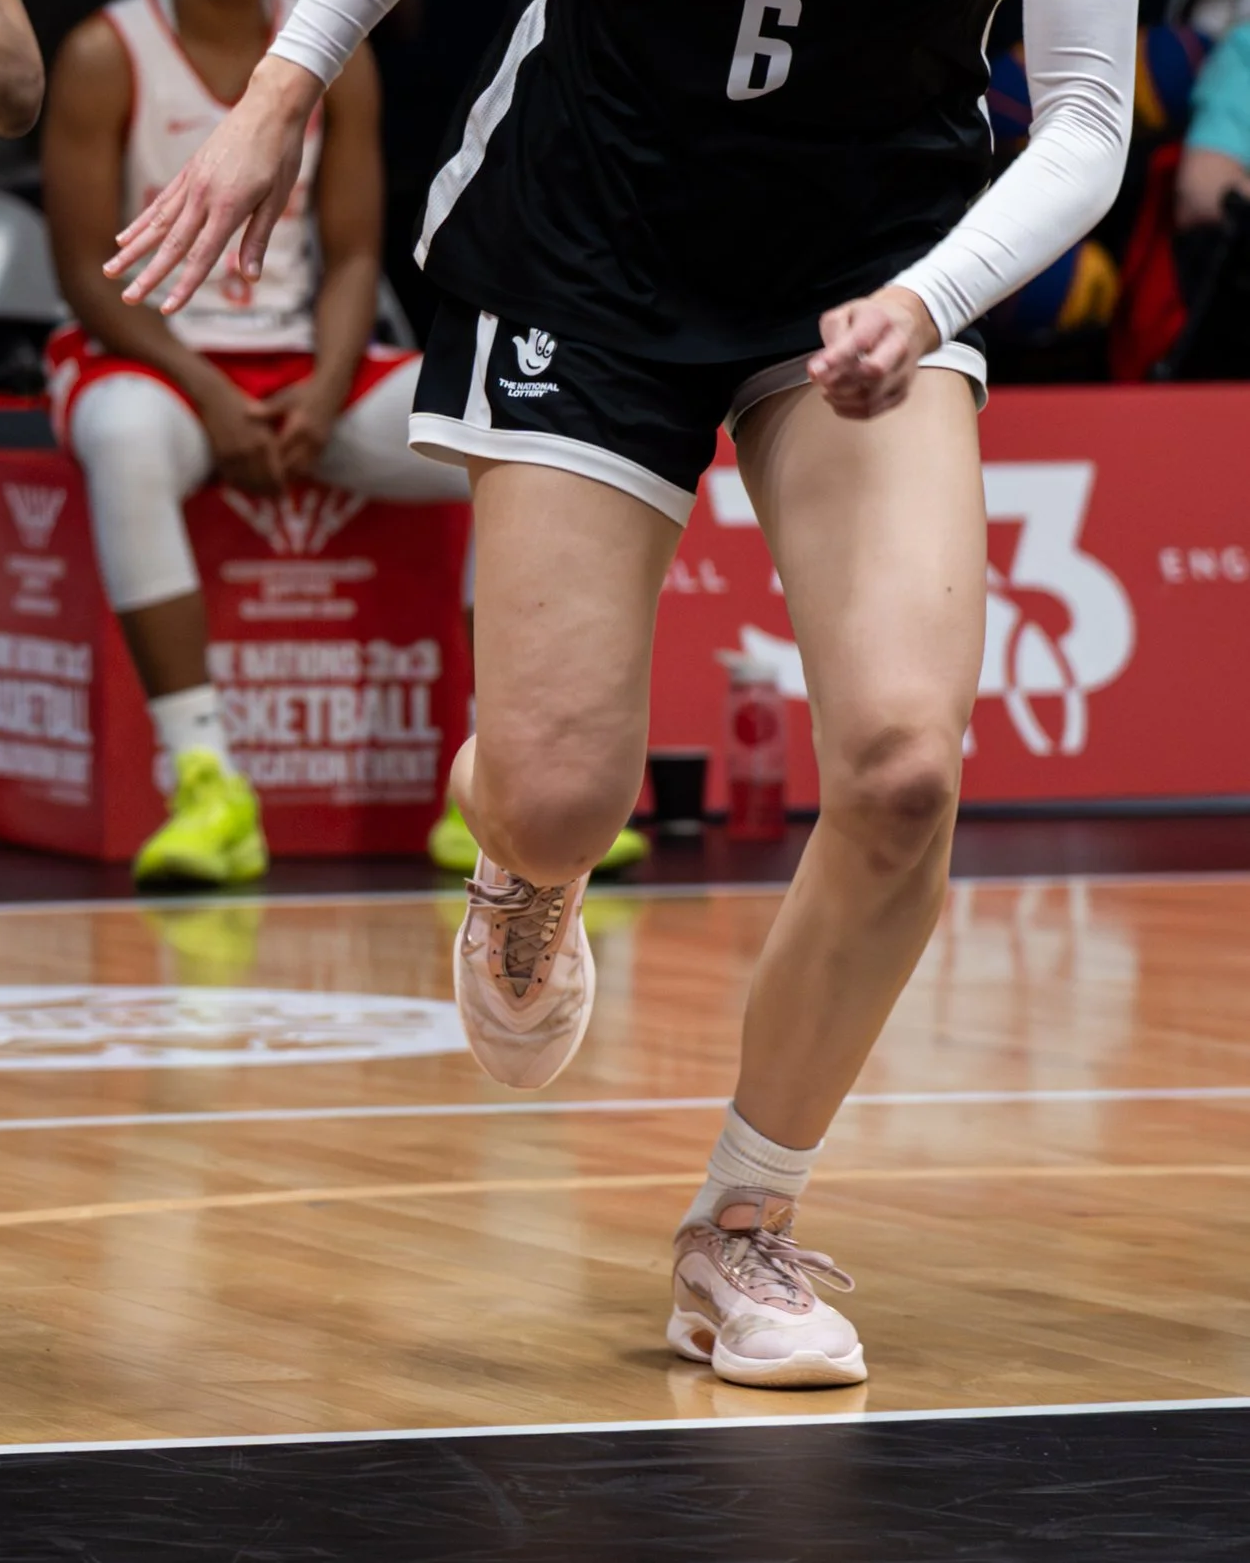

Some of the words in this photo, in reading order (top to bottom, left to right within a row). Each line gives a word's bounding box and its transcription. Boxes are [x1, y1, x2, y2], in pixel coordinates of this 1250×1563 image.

[498, 377, 518, 390] THE
[516, 382, 560, 392] NATIONAL
[507, 389, 547, 398] LOTTERY
[220, 683, 443, 744] SKETBALL
